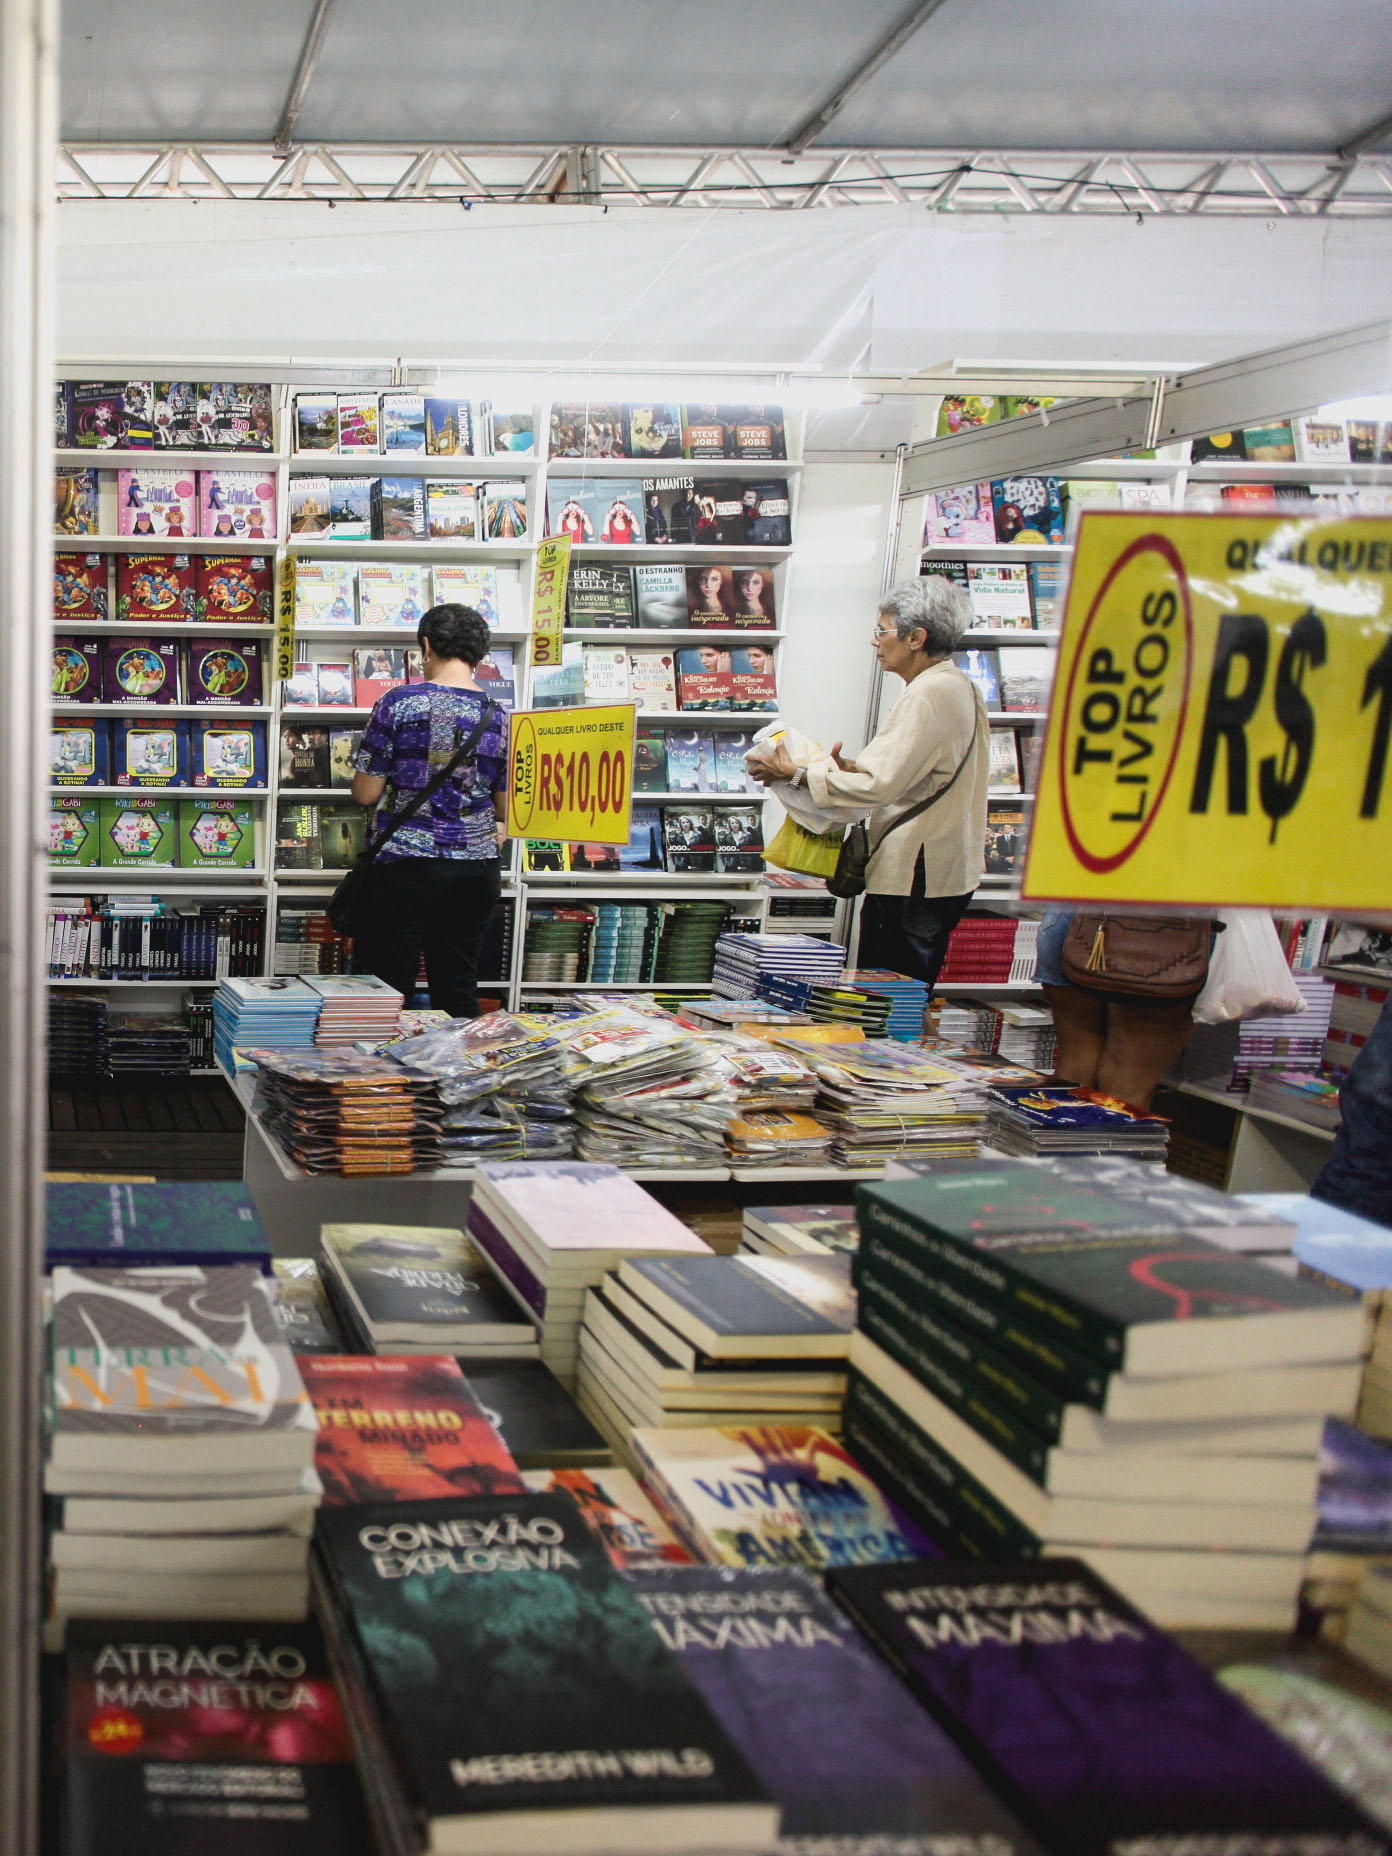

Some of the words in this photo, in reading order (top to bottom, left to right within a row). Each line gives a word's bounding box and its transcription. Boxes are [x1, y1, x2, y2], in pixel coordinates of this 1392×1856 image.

[231, 417, 250, 431] 3D
[457, 405, 471, 448] LONDRES
[691, 430, 720, 439] STEVE
[693, 438, 718, 447] JOBS
[739, 430, 768, 439] STEVE
[742, 438, 766, 447] JOBS
[333, 480, 370, 490] BRASIL
[643, 479, 655, 492] OS
[656, 476, 695, 490] AMANTES
[1126, 488, 1161, 505] SPA
[128, 555, 166, 568] SUPERMAN
[205, 557, 242, 571] SUPERMAN
[921, 560, 965, 570] moothies
[573, 570, 601, 580] ERIN
[645, 566, 683, 575] ESTRANHO
[535, 569, 556, 599] R$
[574, 578, 608, 590] KELLY
[640, 578, 673, 586] CAMILLA
[994, 586, 1025, 594] Natural
[280, 589, 292, 617] R$
[581, 594, 609, 602] ÁRVORE
[159, 612, 185, 620] Justiça
[236, 614, 262, 622] Justiça
[735, 616, 771, 627] nesperado
[533, 605, 553, 662] 15,00
[277, 623, 290, 679] 15,00
[696, 686, 730, 695] Redenção
[744, 686, 774, 696] Redenção
[1074, 647, 1126, 776] TOP
[1110, 589, 1178, 823] LIVROS
[537, 724, 574, 736] QUALQUER
[575, 723, 598, 734] LIVRO
[599, 722, 625, 733] DESTE
[514, 750, 527, 798] TOP
[524, 743, 534, 805] LIVROS
[539, 748, 626, 828] R$10,00
[315, 1408, 464, 1431] TERRENO
[358, 1428, 460, 1446] MINADO
[358, 1513, 564, 1555] CONEXÃO
[371, 1545, 582, 1580] EXPLOSIVA
[638, 1590, 805, 1617] TENSIDADE
[882, 1582, 1091, 1614] INTENSIDADE
[904, 1609, 1146, 1651] MÁXIMA
[94, 1637, 307, 1679] ATRAÇÃO
[95, 1674, 321, 1711] MAGNÉTICA
[449, 1751, 633, 1788] MEREDITH
[634, 1748, 715, 1780] WILD
